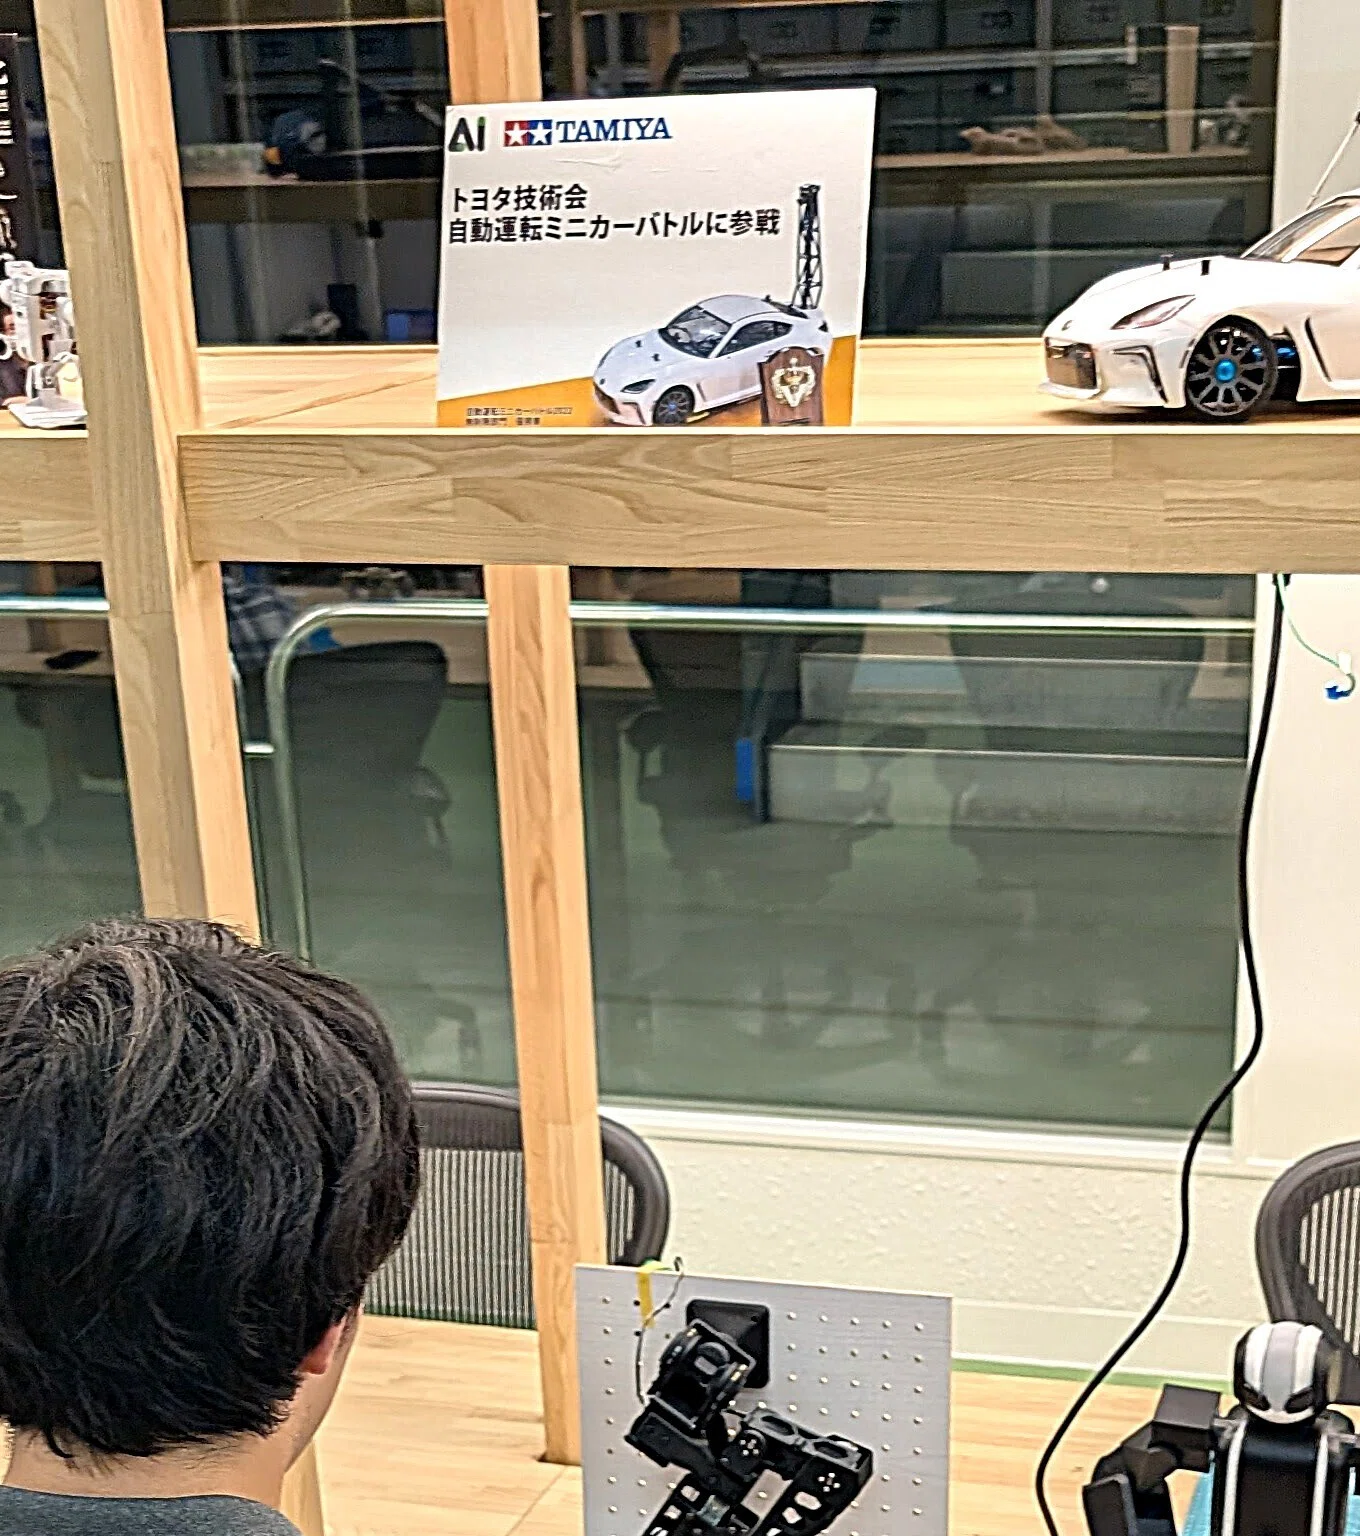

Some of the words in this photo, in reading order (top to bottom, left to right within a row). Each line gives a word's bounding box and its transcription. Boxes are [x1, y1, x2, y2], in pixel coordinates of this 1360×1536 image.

[556, 117, 673, 143] TAMIYA
[452, 183, 588, 213] トヨタ技術会
[449, 208, 781, 244] 自動運転ミニカーバトルに参戦
